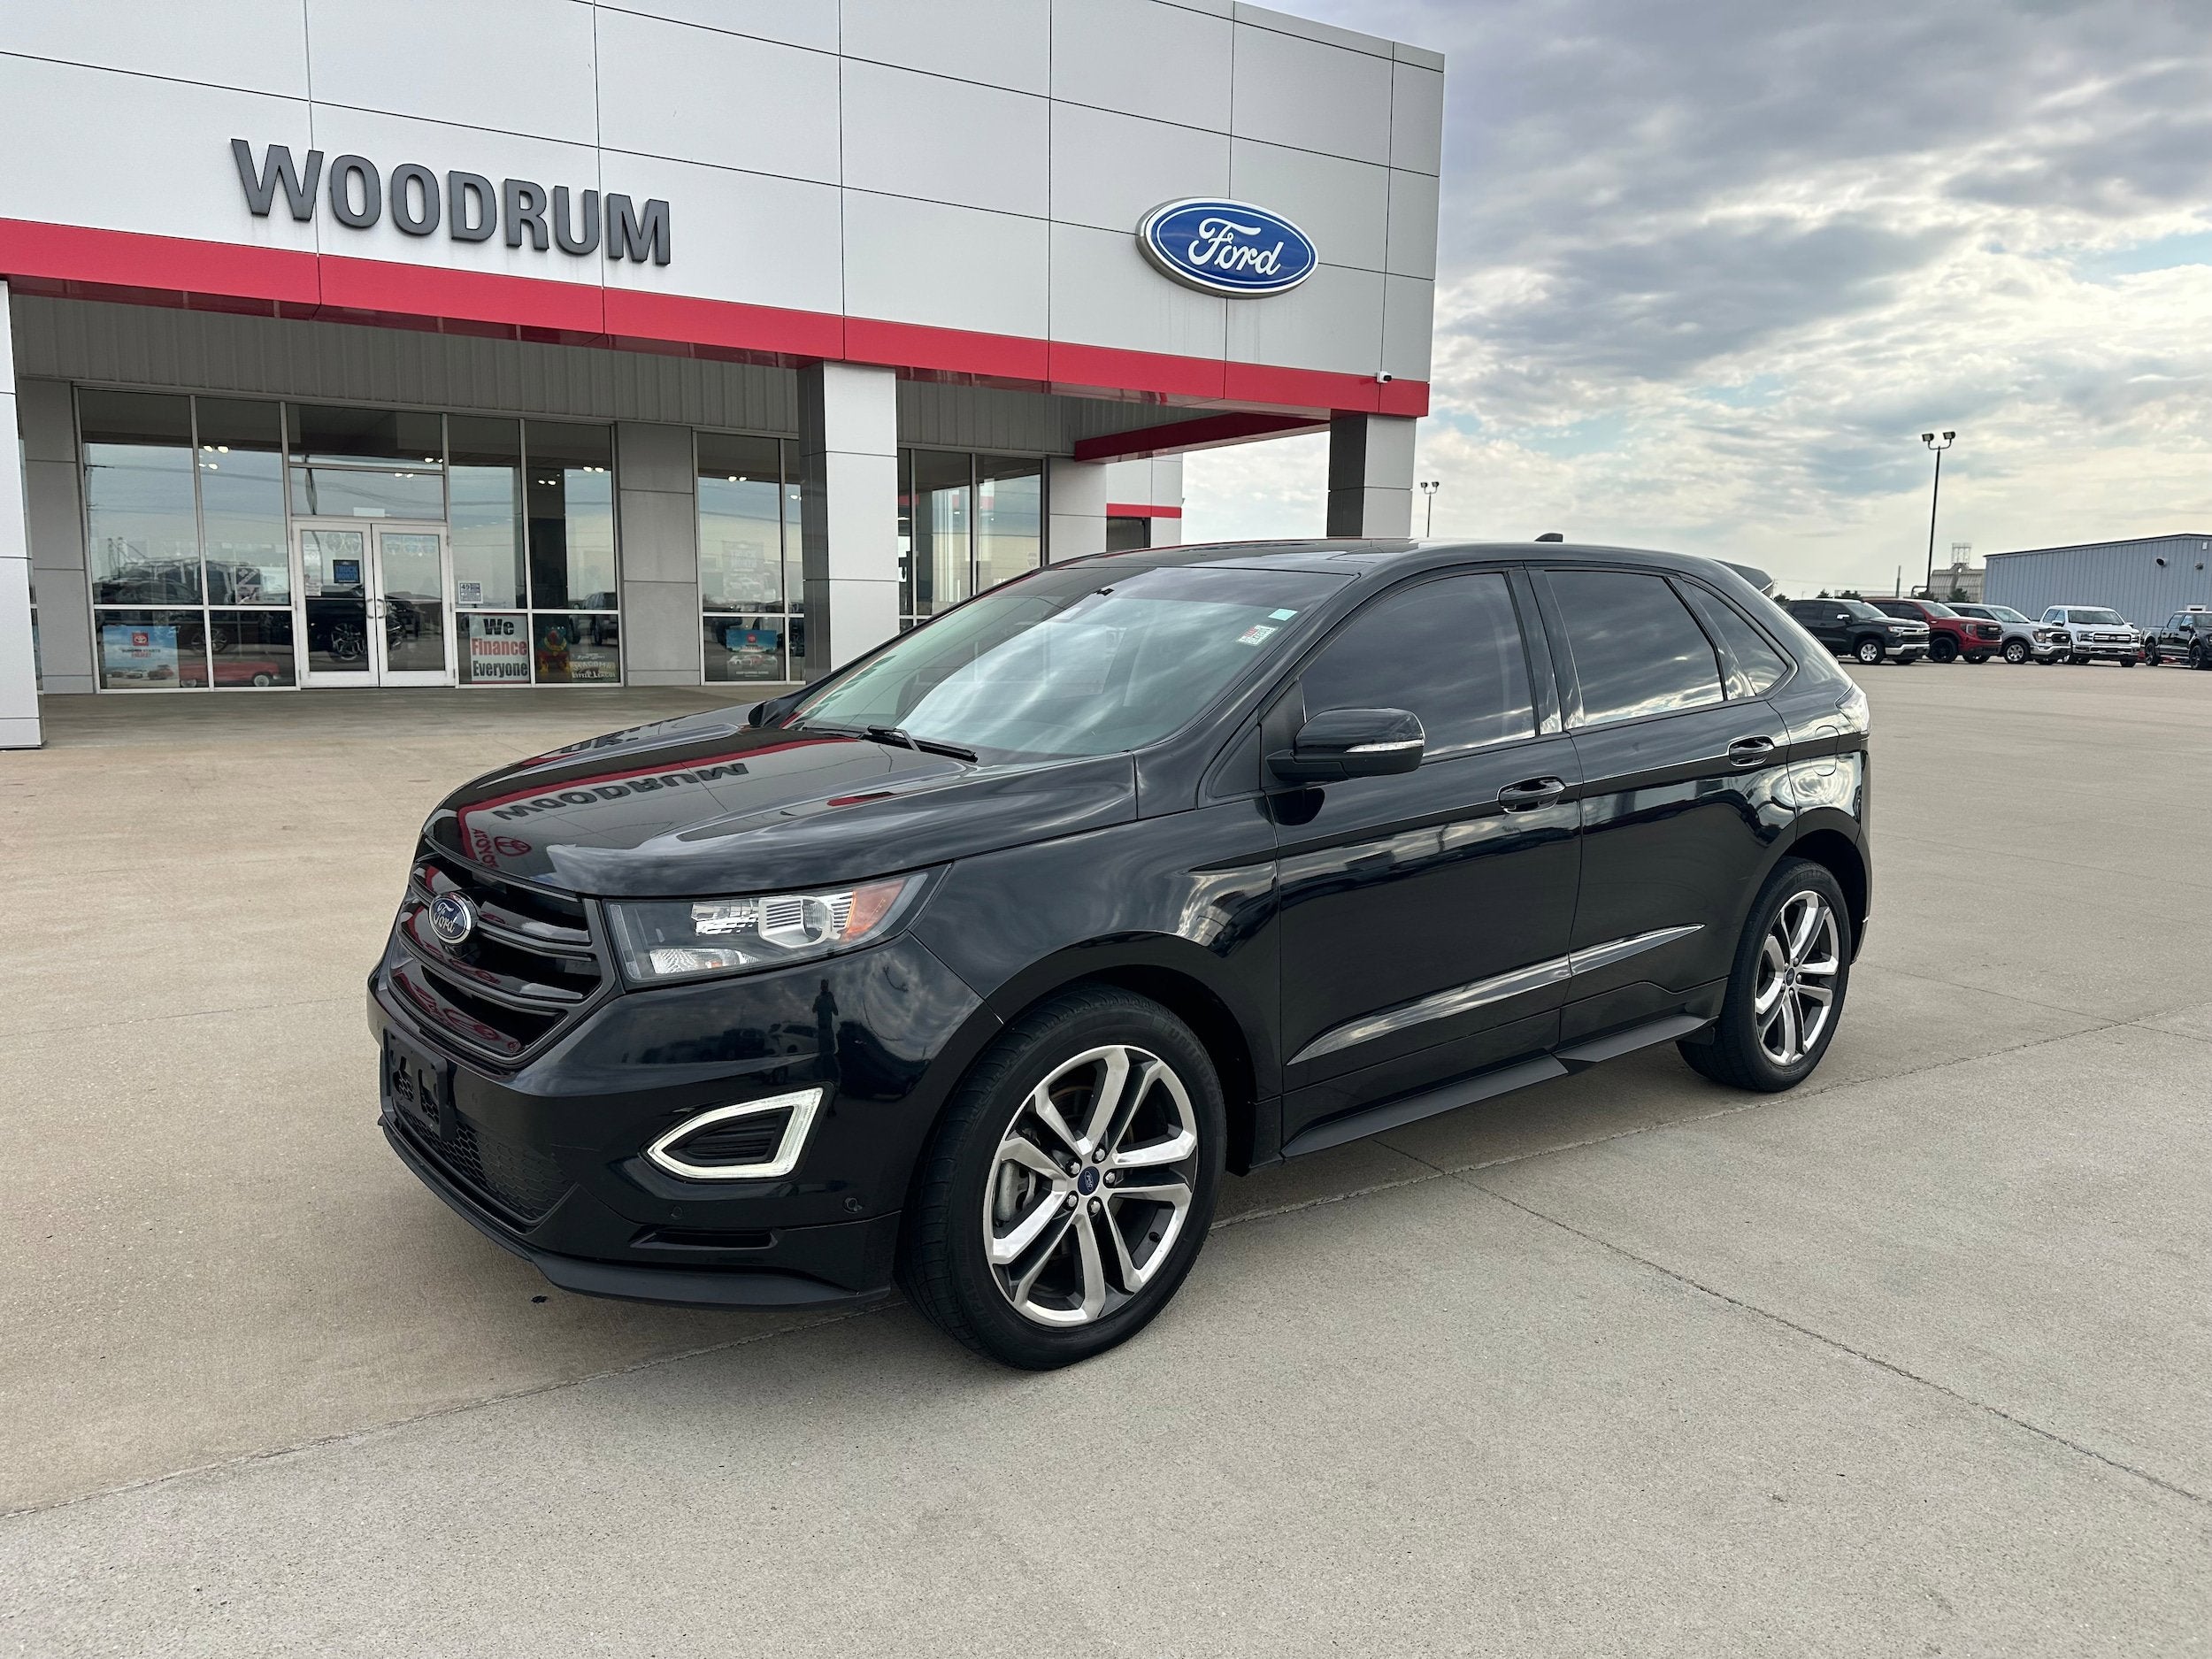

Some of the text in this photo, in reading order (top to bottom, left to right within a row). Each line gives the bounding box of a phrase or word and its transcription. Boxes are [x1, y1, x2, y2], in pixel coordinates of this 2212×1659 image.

[231, 138, 671, 266] WOODRUM
[1187, 217, 1285, 276] Ford
[483, 618, 515, 635] We
[472, 638, 528, 656] Finance
[472, 660, 528, 678] Everyone
[434, 902, 457, 933] Ford
